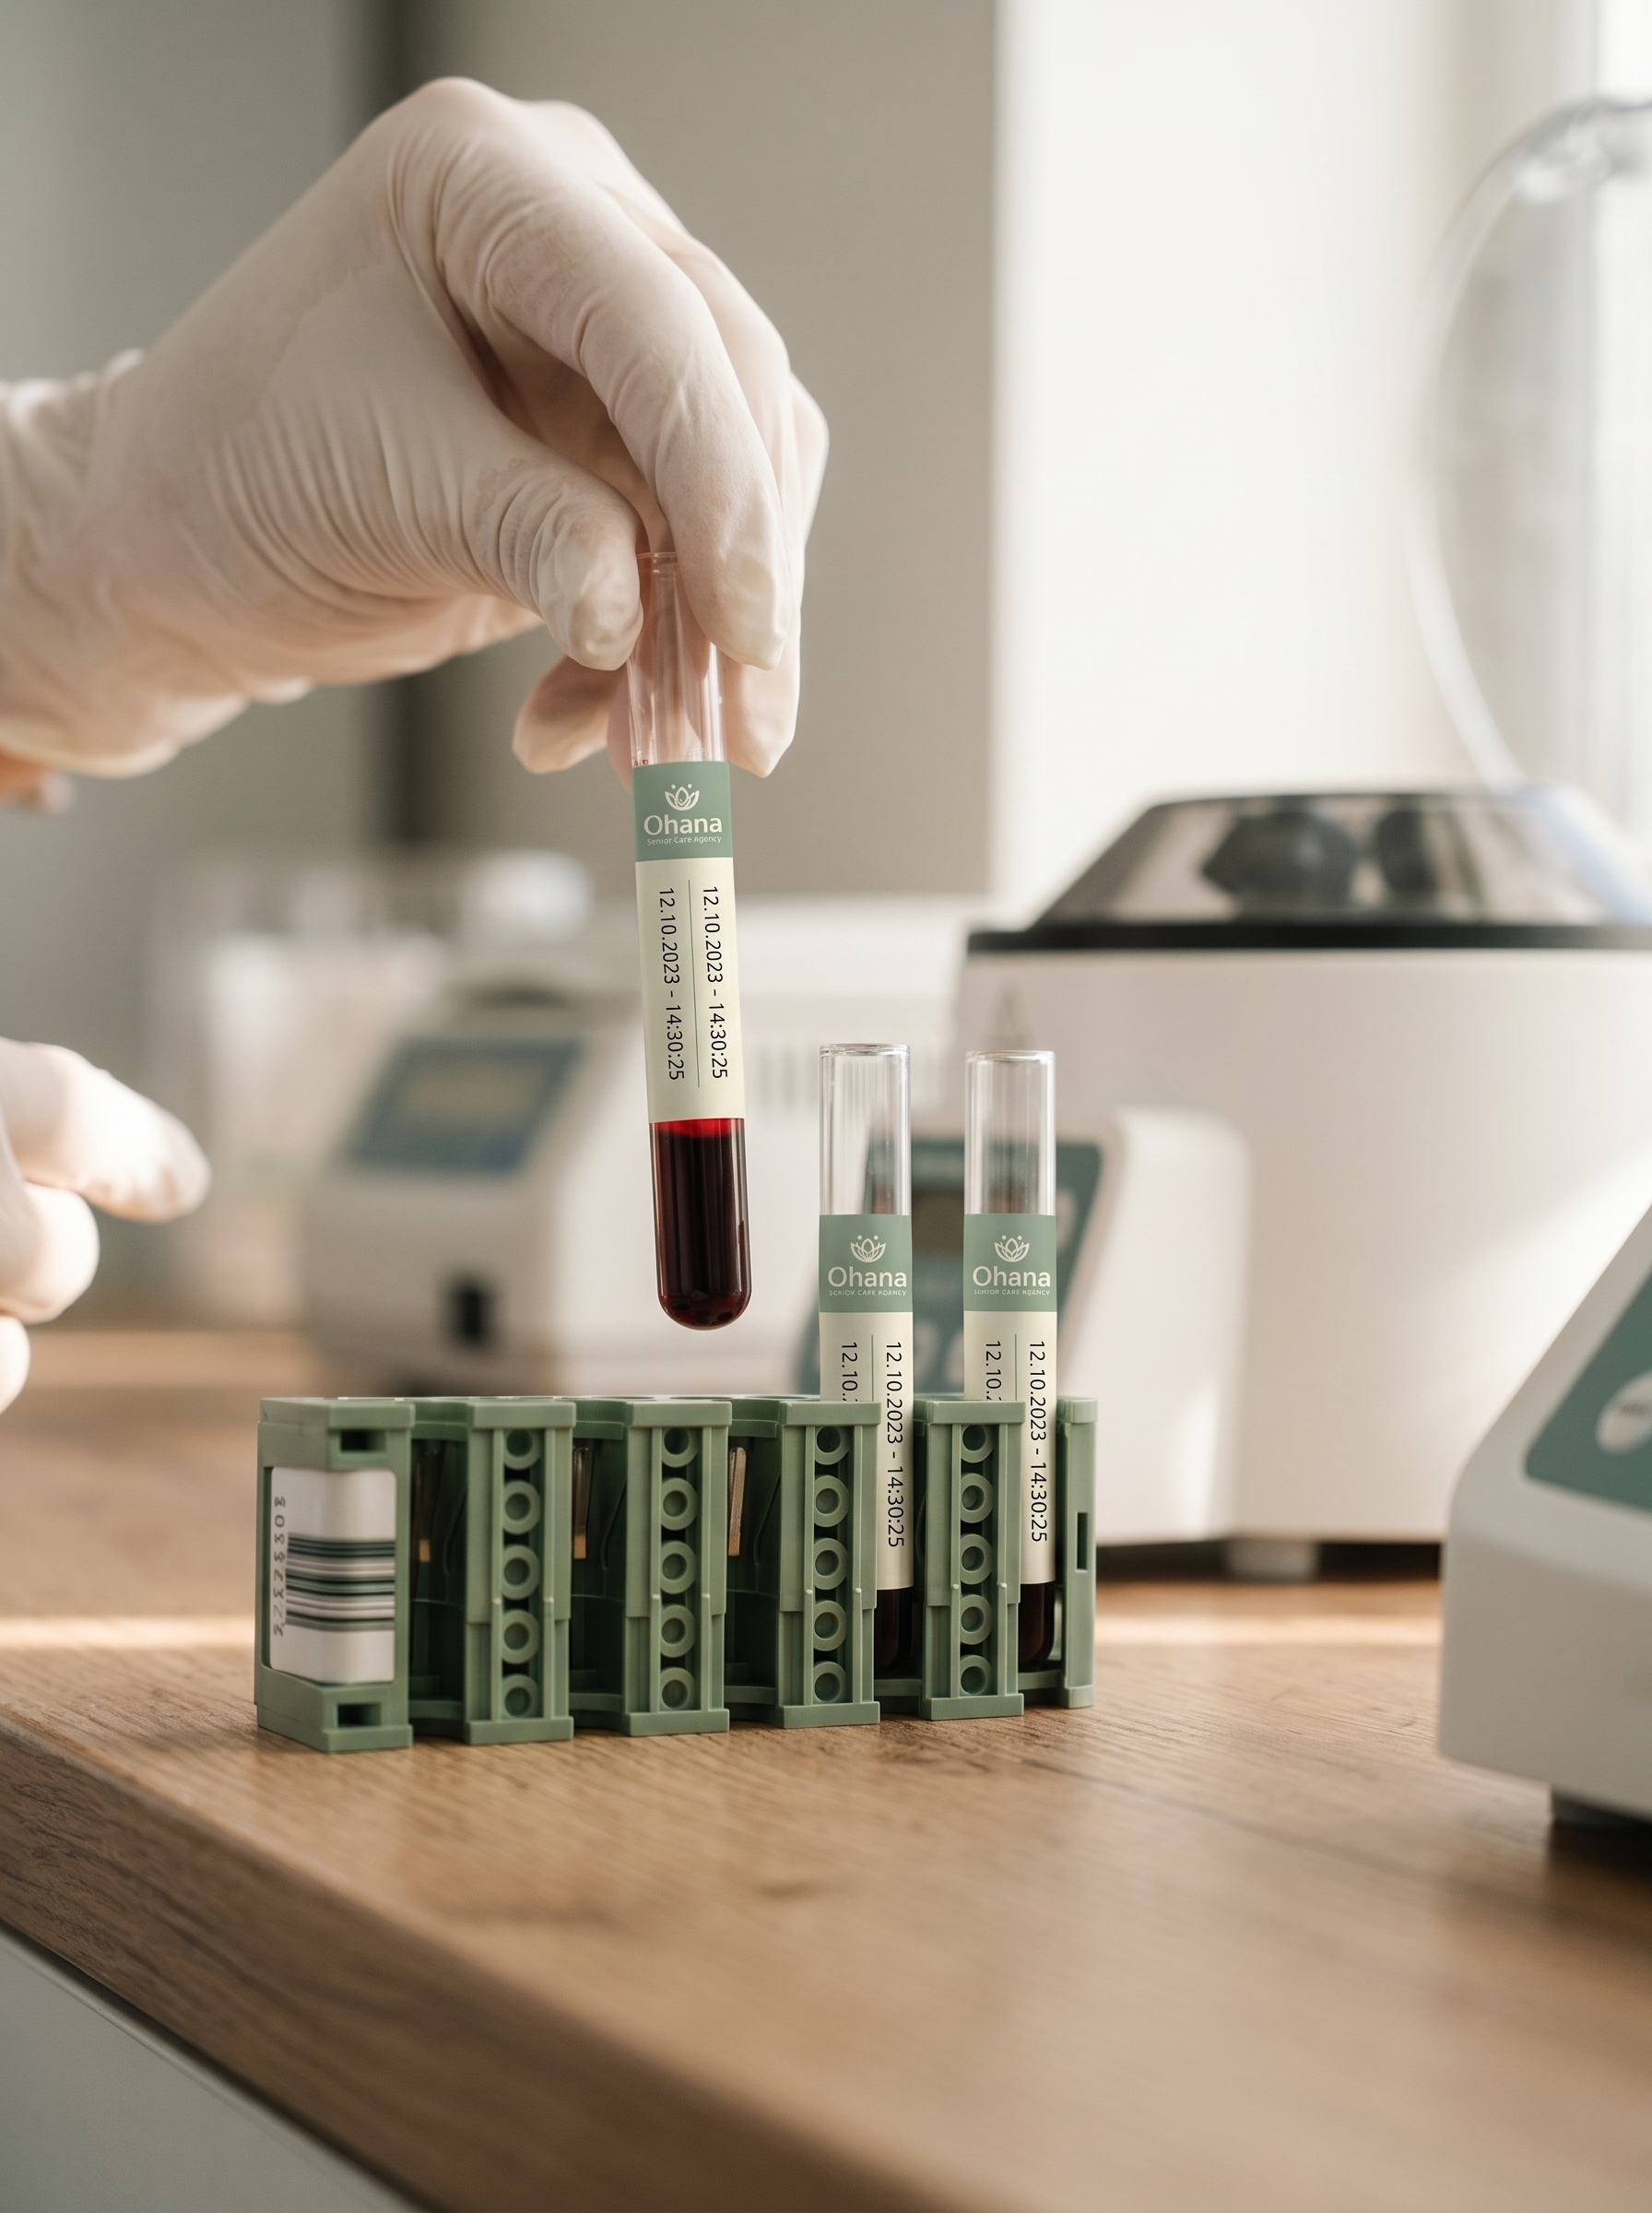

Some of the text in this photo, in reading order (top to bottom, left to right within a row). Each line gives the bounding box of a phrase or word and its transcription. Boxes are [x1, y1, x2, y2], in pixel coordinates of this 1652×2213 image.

[643, 814, 723, 835] Ohana
[659, 888, 681, 984] 12.10.2023
[703, 886, 724, 983] 12.10.2023
[666, 1004, 685, 1081] 14:30:25
[709, 1003, 728, 1079] 14:30:25
[827, 1266, 907, 1287] Ohana
[973, 1265, 1051, 1286] Ohana
[841, 1342, 858, 1402] 12.10.
[886, 1342, 903, 1444] 12.10.2023
[1030, 1341, 1046, 1441] 12.10.2023
[887, 1466, 904, 1547] 14:30:25
[1031, 1462, 1047, 1542] 14:30:25
